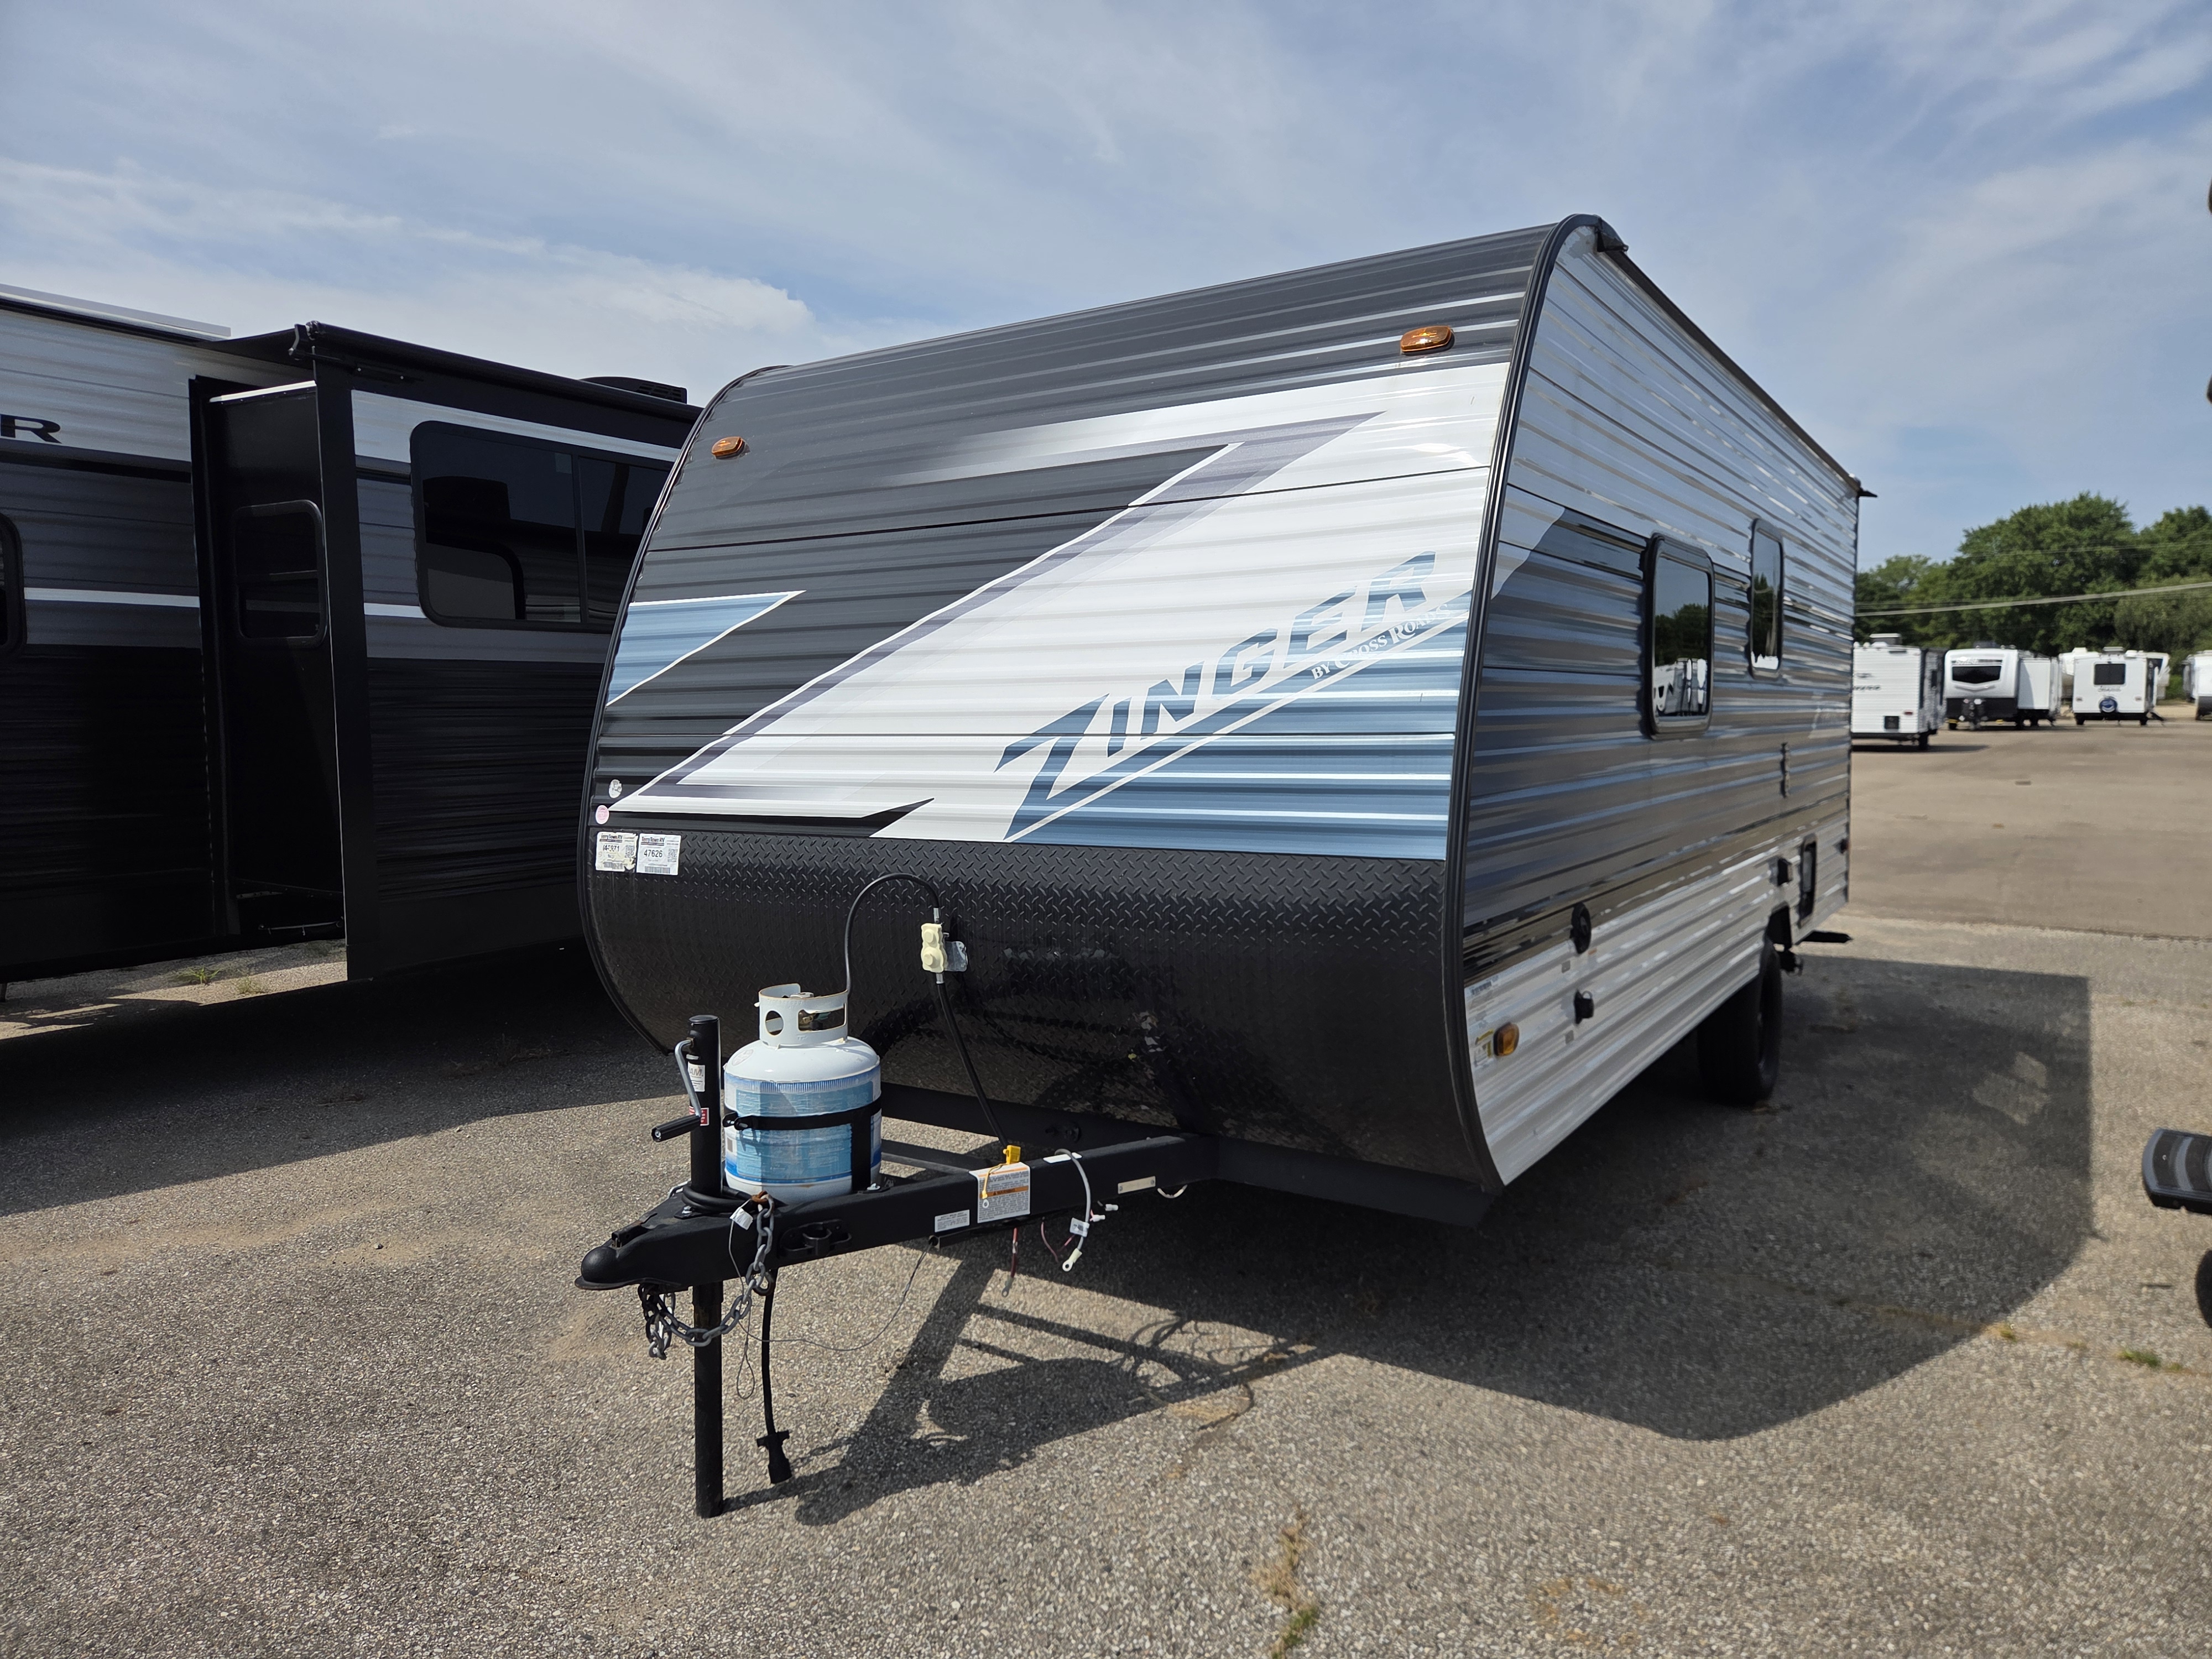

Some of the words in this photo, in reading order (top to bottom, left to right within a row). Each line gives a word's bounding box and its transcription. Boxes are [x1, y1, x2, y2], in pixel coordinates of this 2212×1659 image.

[1311, 661, 1331, 680] BY
[993, 550, 1437, 842] ZINGER
[644, 849, 663, 858] 47626
